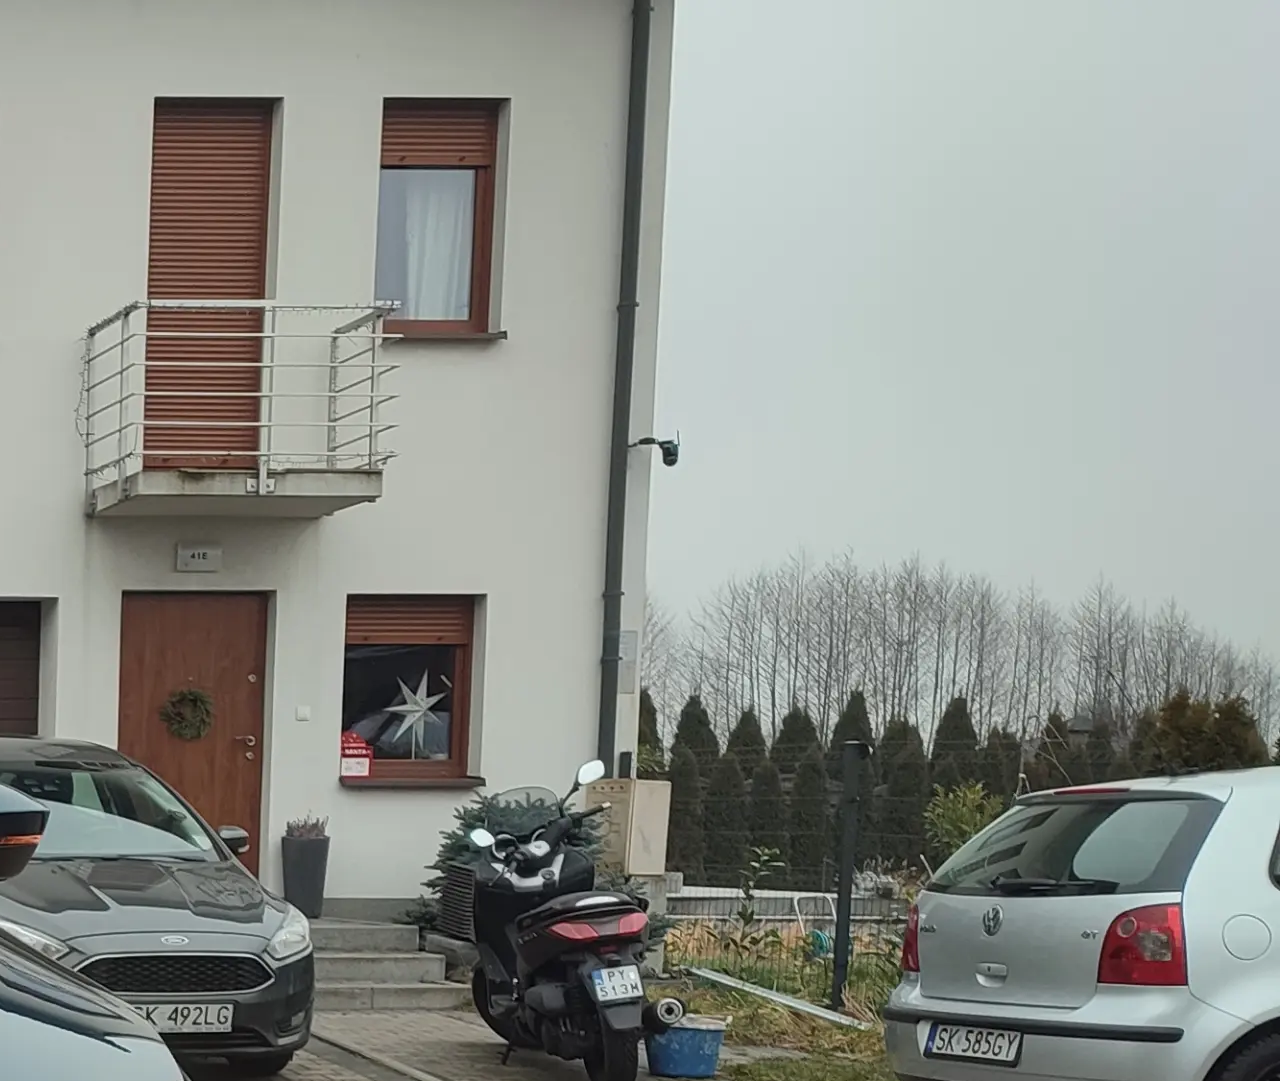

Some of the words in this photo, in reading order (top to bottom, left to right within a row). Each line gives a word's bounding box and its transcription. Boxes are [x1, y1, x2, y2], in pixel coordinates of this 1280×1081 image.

[607, 969, 625, 983] PY
[167, 1006, 230, 1026] 492LG
[936, 1027, 960, 1052] SK
[961, 1029, 1019, 1058] 585GY
